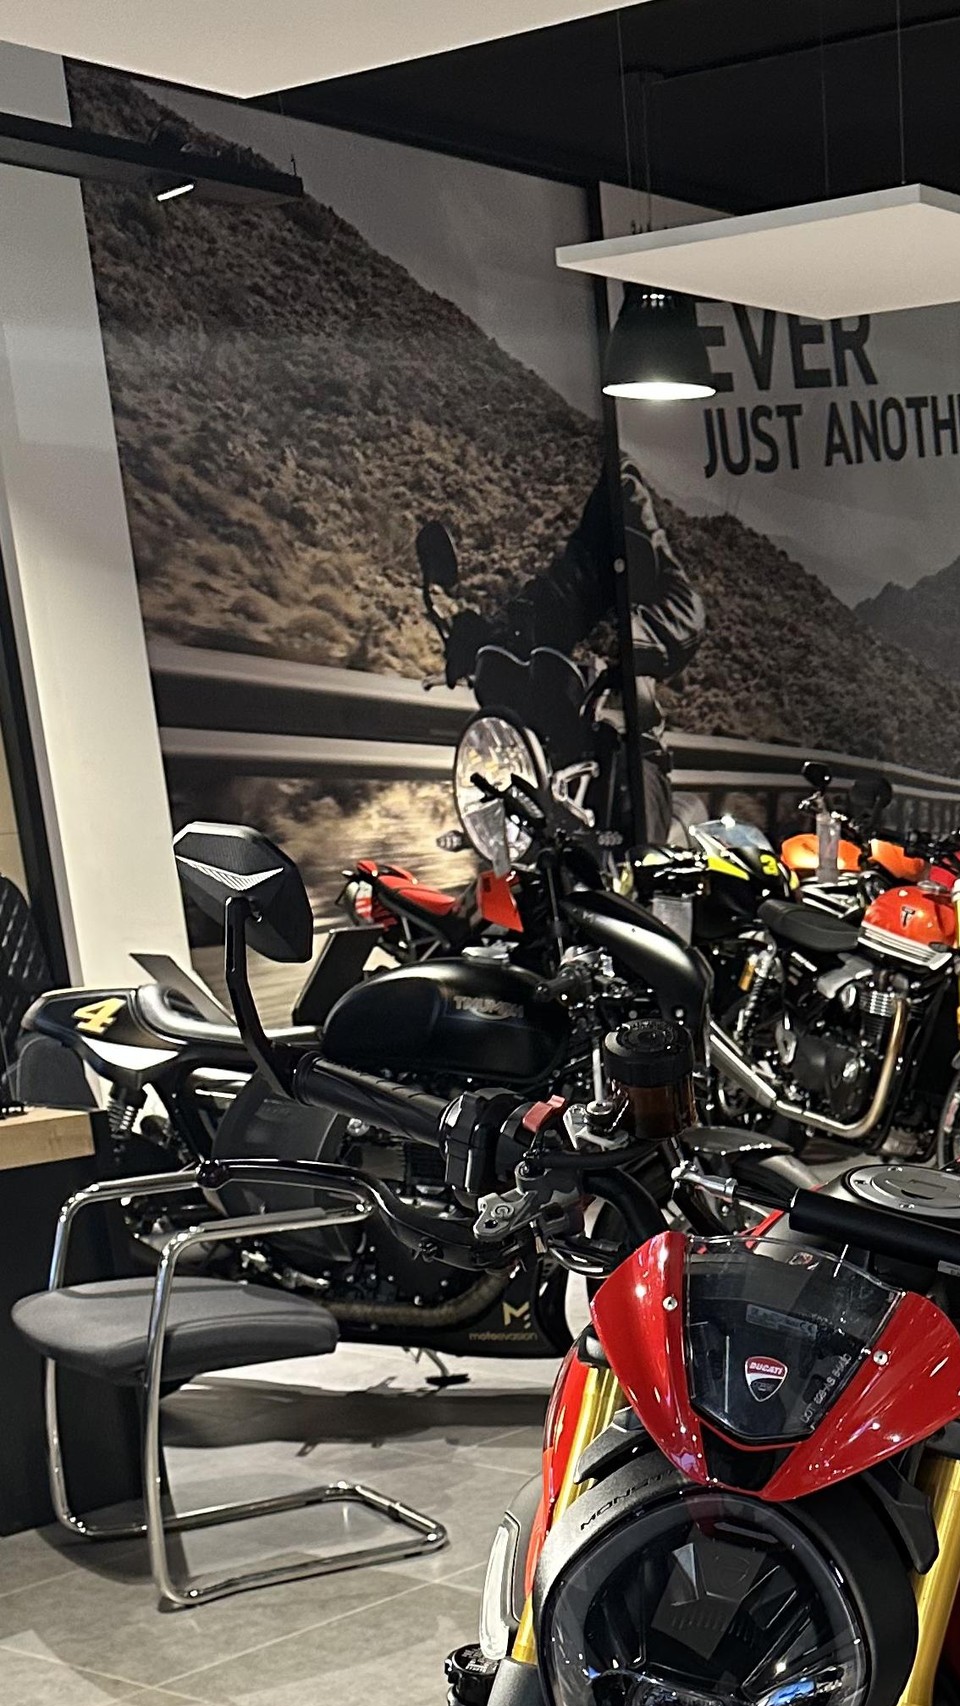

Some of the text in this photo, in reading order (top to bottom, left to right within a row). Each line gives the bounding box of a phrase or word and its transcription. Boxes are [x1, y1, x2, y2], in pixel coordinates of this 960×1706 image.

[704, 403, 802, 478] JUST
[71, 997, 127, 1034] 4
[749, 1361, 783, 1375] DUCATI
